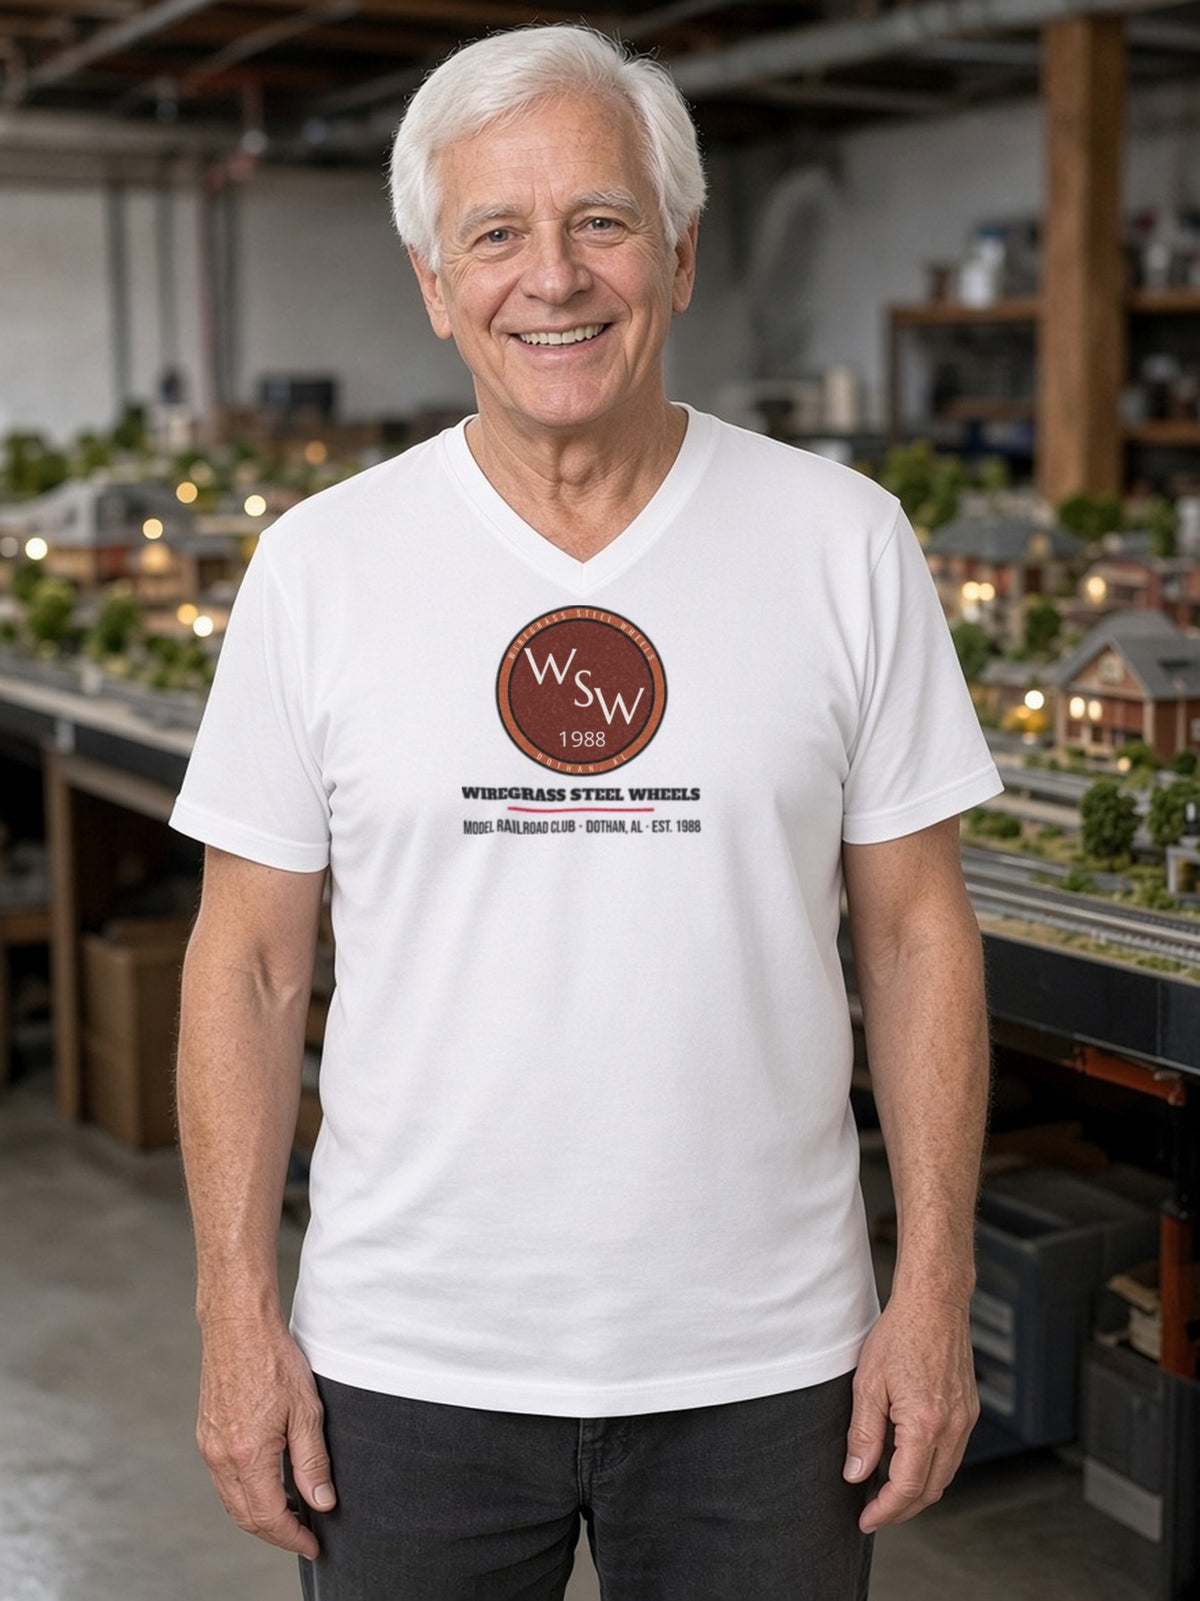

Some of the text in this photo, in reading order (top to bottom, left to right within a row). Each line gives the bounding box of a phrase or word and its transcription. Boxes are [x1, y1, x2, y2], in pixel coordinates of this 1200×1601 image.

[508, 609, 655, 661] WIREGRASS STEEL WHEELS
[559, 731, 606, 748] 1988
[613, 753, 628, 766] AL
[462, 787, 701, 802] WIREGRASS STEEL WHEELS
[463, 819, 702, 835] MODEL RAILROAD CLUB DOTHAN, AL EST. 1988
